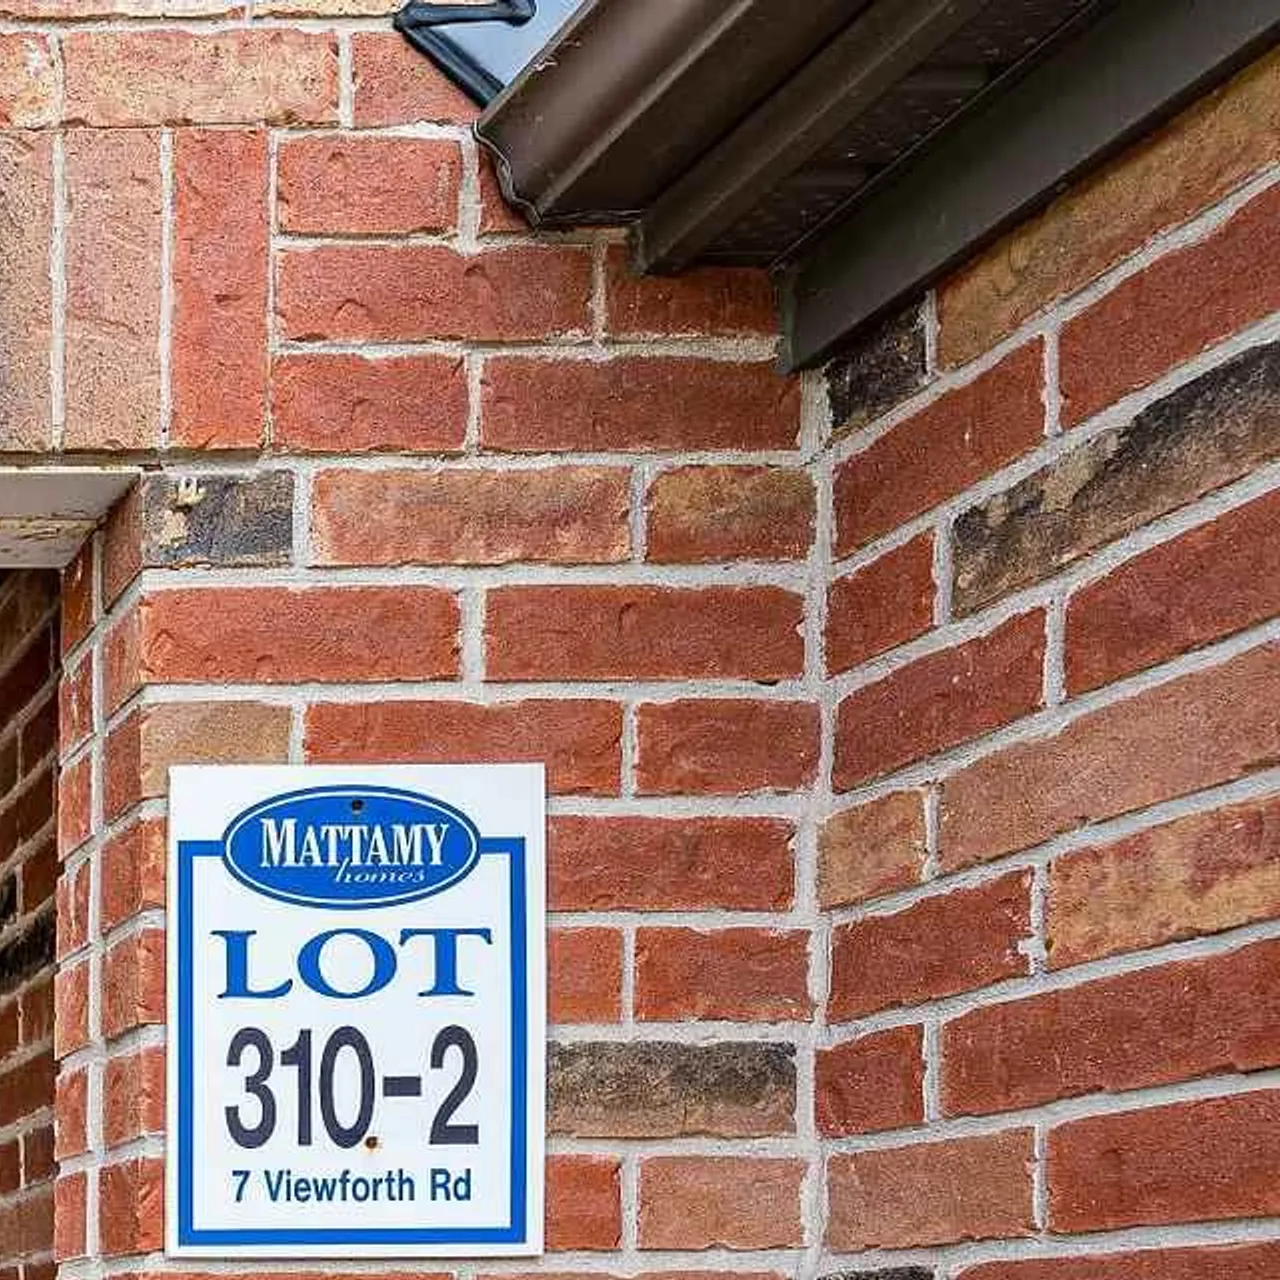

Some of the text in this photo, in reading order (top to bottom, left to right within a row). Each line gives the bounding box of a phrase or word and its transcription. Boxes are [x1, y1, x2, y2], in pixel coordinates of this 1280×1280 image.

[260, 818, 449, 868] MATTAMY
[335, 858, 426, 884] homes
[210, 928, 493, 999] LOT
[225, 1024, 480, 1149] 310-2
[232, 1169, 472, 1201] 7 Viewforth Rd
